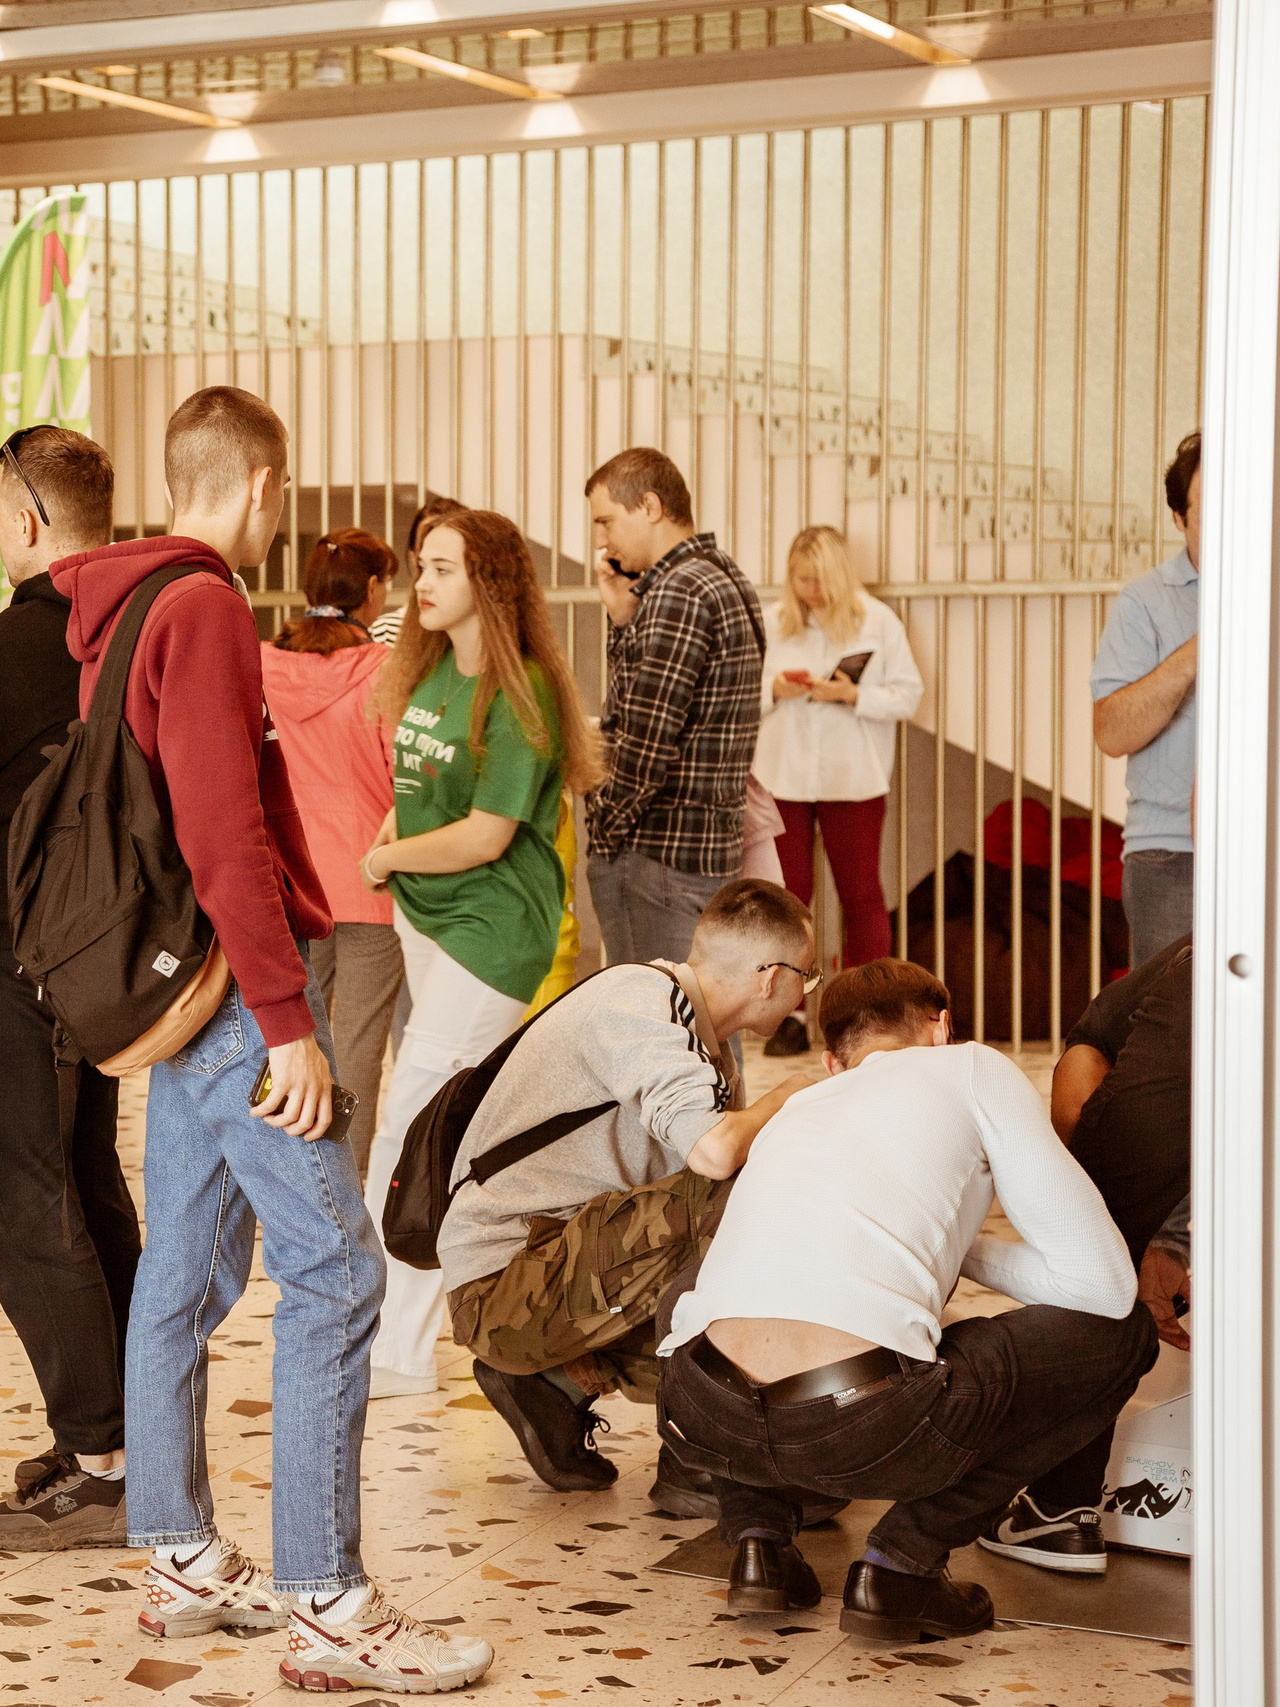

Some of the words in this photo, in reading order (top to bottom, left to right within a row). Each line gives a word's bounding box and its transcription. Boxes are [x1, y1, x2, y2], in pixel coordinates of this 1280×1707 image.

[1126, 1456, 1175, 1469] SHUKHOV
[1142, 1465, 1177, 1476] CYBER
[1150, 1473, 1178, 1483] TEAM
[1079, 1513, 1098, 1524] NIKE
